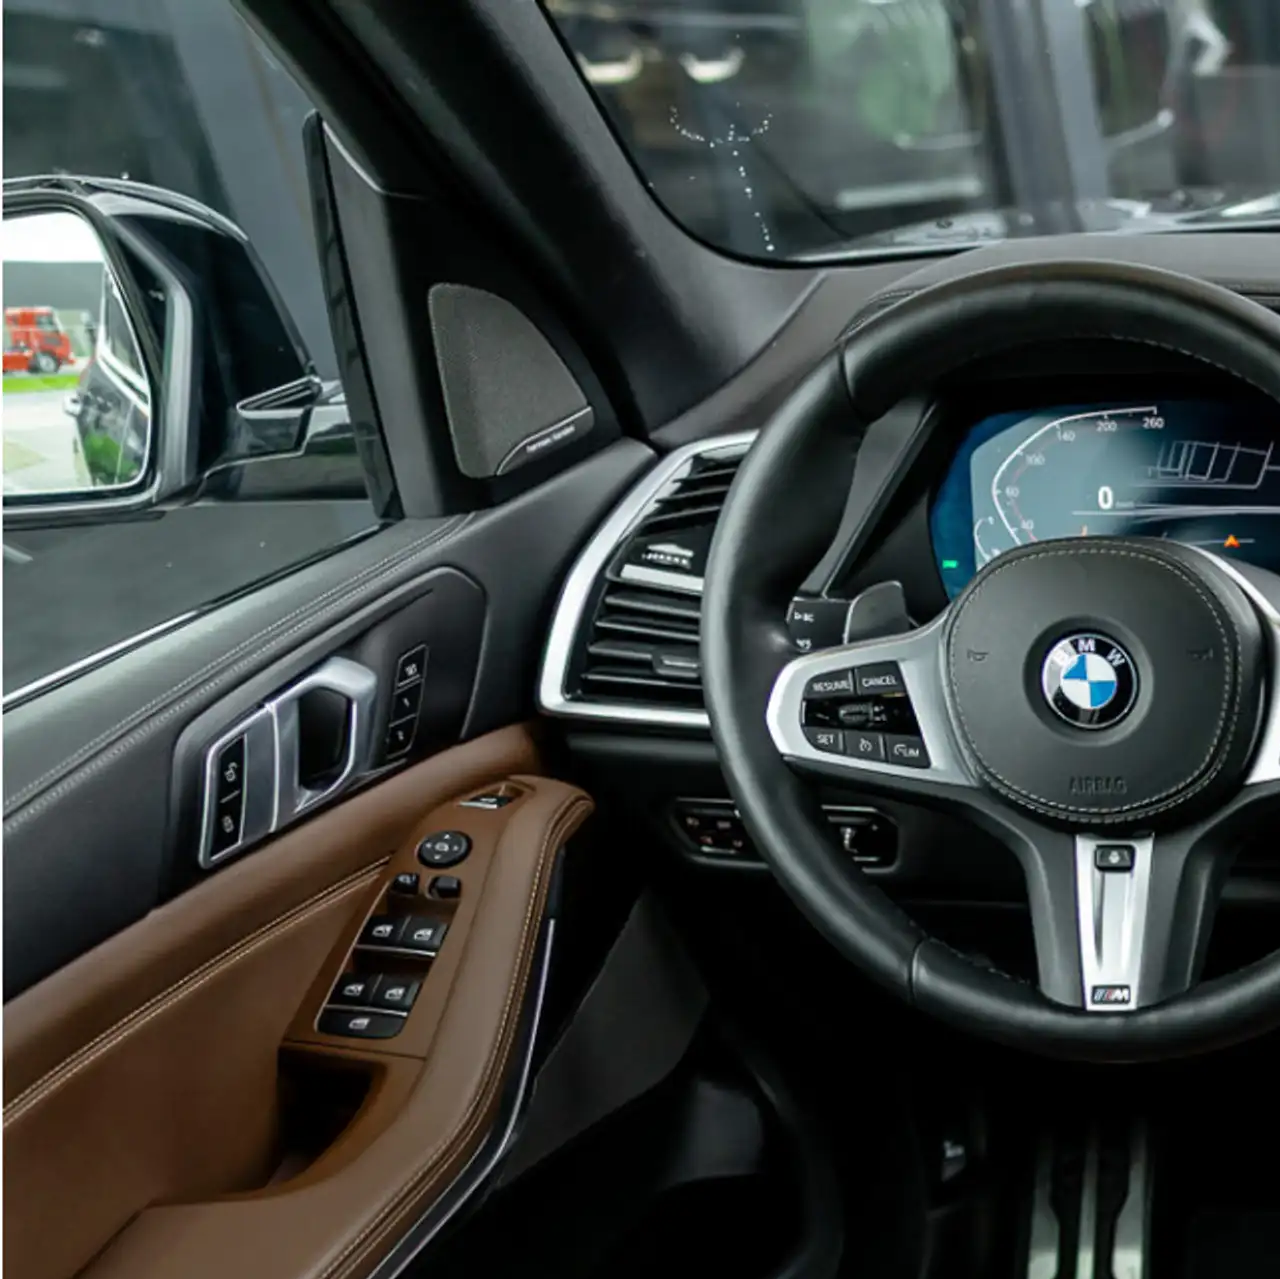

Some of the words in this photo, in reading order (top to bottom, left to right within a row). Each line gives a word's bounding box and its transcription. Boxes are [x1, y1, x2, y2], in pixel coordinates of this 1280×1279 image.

[1096, 420, 1117, 432] 200
[1142, 417, 1164, 429] 260
[1098, 485, 1114, 509] 0
[1051, 638, 1126, 668] BMW
[811, 678, 851, 693] RESUME
[861, 674, 898, 689] CANCEL
[816, 733, 835, 746] SET
[1069, 775, 1128, 796] AIRBAG
